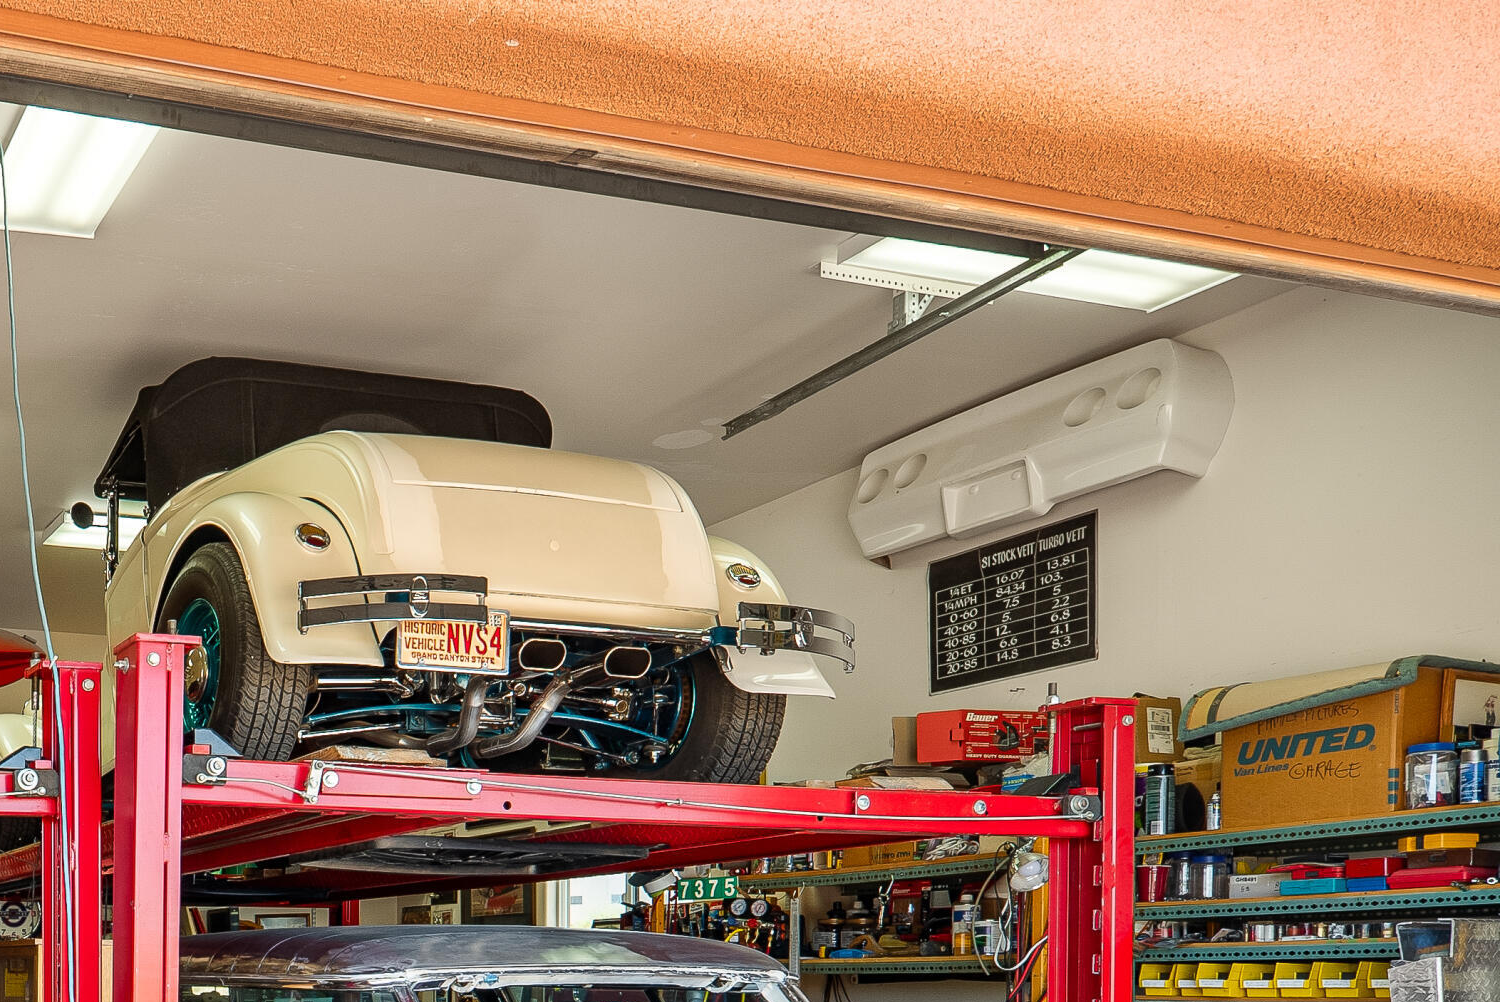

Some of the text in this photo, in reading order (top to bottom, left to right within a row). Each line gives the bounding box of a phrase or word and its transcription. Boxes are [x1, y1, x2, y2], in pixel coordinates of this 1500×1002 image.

[1038, 525, 1088, 553] TURBO VETT
[992, 548, 1016, 566] STOCK
[1016, 542, 1036, 559] VETT
[1046, 554, 1076, 571] 13.81
[996, 569, 1025, 585] 16.07
[995, 582, 1026, 598] 84.34
[1052, 584, 1061, 596] 5
[1003, 596, 1020, 609] 7.5
[1051, 596, 1070, 610] 2.2
[949, 608, 978, 623] 0-60
[1050, 609, 1071, 622] 6.8
[404, 621, 446, 636] HISTORIC
[943, 621, 977, 637] 40-60
[1050, 623, 1070, 635] 4.1
[404, 636, 445, 652] VEHICLE
[447, 622, 502, 658] NVS4
[944, 634, 976, 649] 40-85
[999, 636, 1018, 649] 6.6
[1051, 635, 1071, 650] 8.3
[411, 651, 495, 665] GRAND CANYON STATE
[945, 646, 978, 662] 20-60
[996, 649, 1019, 662] 14.8
[946, 658, 978, 675] 20-85
[965, 712, 998, 723] Bauer
[1237, 723, 1376, 766] UNITED
[1234, 763, 1290, 778] Van Lines
[1288, 760, 1363, 780] GARAGE
[679, 876, 736, 899] 7375
